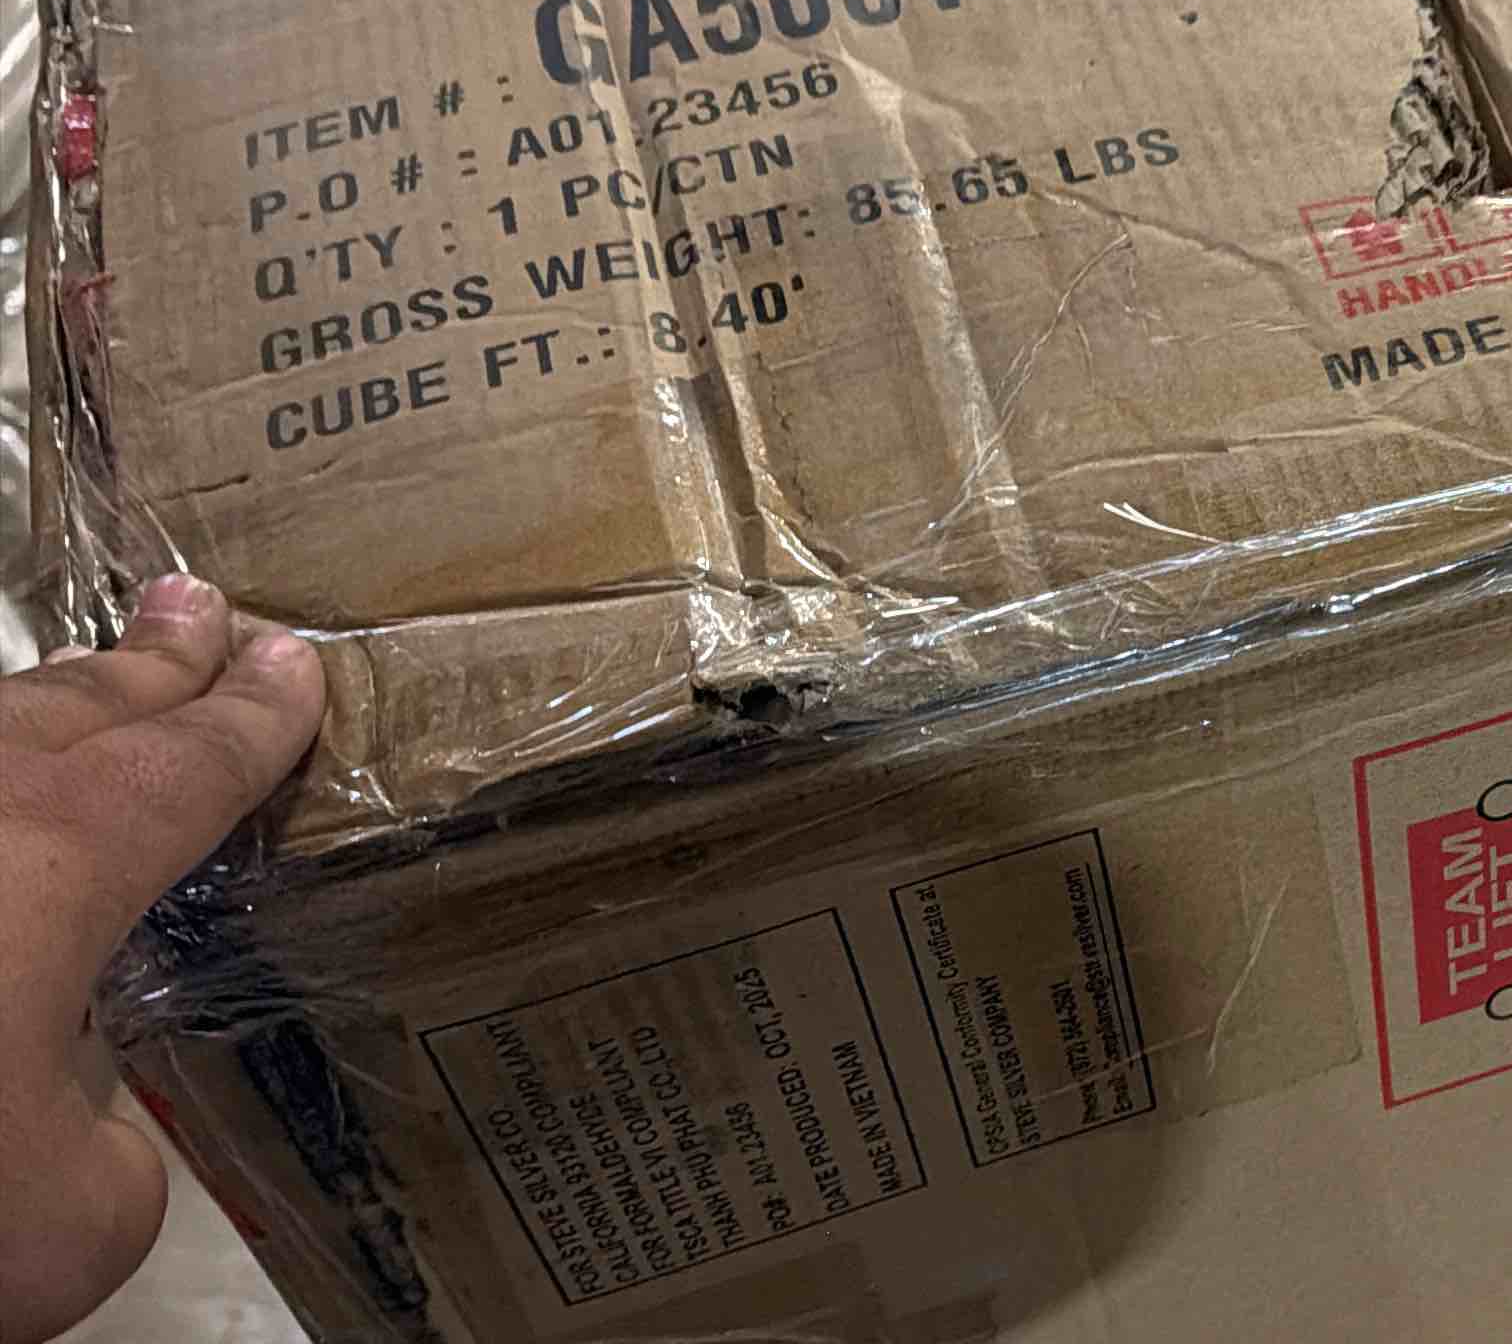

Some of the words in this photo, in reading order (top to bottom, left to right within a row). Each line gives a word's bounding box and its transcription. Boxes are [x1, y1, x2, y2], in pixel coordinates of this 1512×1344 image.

[245, 95, 400, 168] ITEM
[432, 80, 465, 117] #
[249, 171, 360, 232] P.O
[391, 153, 423, 195] #
[507, 61, 839, 166] A01.23456
[254, 225, 403, 301] Q'TY
[487, 197, 518, 236] 1
[560, 133, 794, 218] PC/CTN
[259, 273, 494, 374] GROSS
[524, 204, 817, 300] WEIGHT:
[846, 158, 1029, 225] 85.65
[1053, 127, 1180, 185] LBS
[1321, 314, 1512, 391] MADE
[265, 361, 452, 450] CUBE
[919, 903, 959, 981] Certificate
[1440, 826, 1489, 997] TEAM
[733, 967, 776, 1015] 2025
[944, 981, 982, 1060] Conformity
[974, 974, 1015, 1048] COMPANY
[485, 1019, 569, 1134] COMPLIANT
[587, 1037, 659, 1146] COMPLIANT
[831, 1039, 881, 1125] VIETNAM
[996, 1045, 1029, 1100] SILVER
[661, 1103, 708, 1153] PHAT
[776, 1060, 835, 1169] PRODUCED:
[858, 1121, 888, 1145] IN
[501, 1137, 559, 1205] SILVER
[569, 1091, 660, 1237] FORMALDEHYDE
[639, 1145, 669, 1171] VI
[648, 1165, 695, 1218] TITLE
[683, 1152, 722, 1193] PHU
[813, 1165, 853, 1218] DATE
[867, 1142, 910, 1199] MADE
[537, 1203, 588, 1263] STEVE
[572, 1183, 641, 1284] CALIFORNIA
[640, 1234, 678, 1273] FOR
[673, 1212, 712, 1262] TSCA
[700, 1189, 748, 1249] THANH
[567, 1255, 606, 1296] FOR
